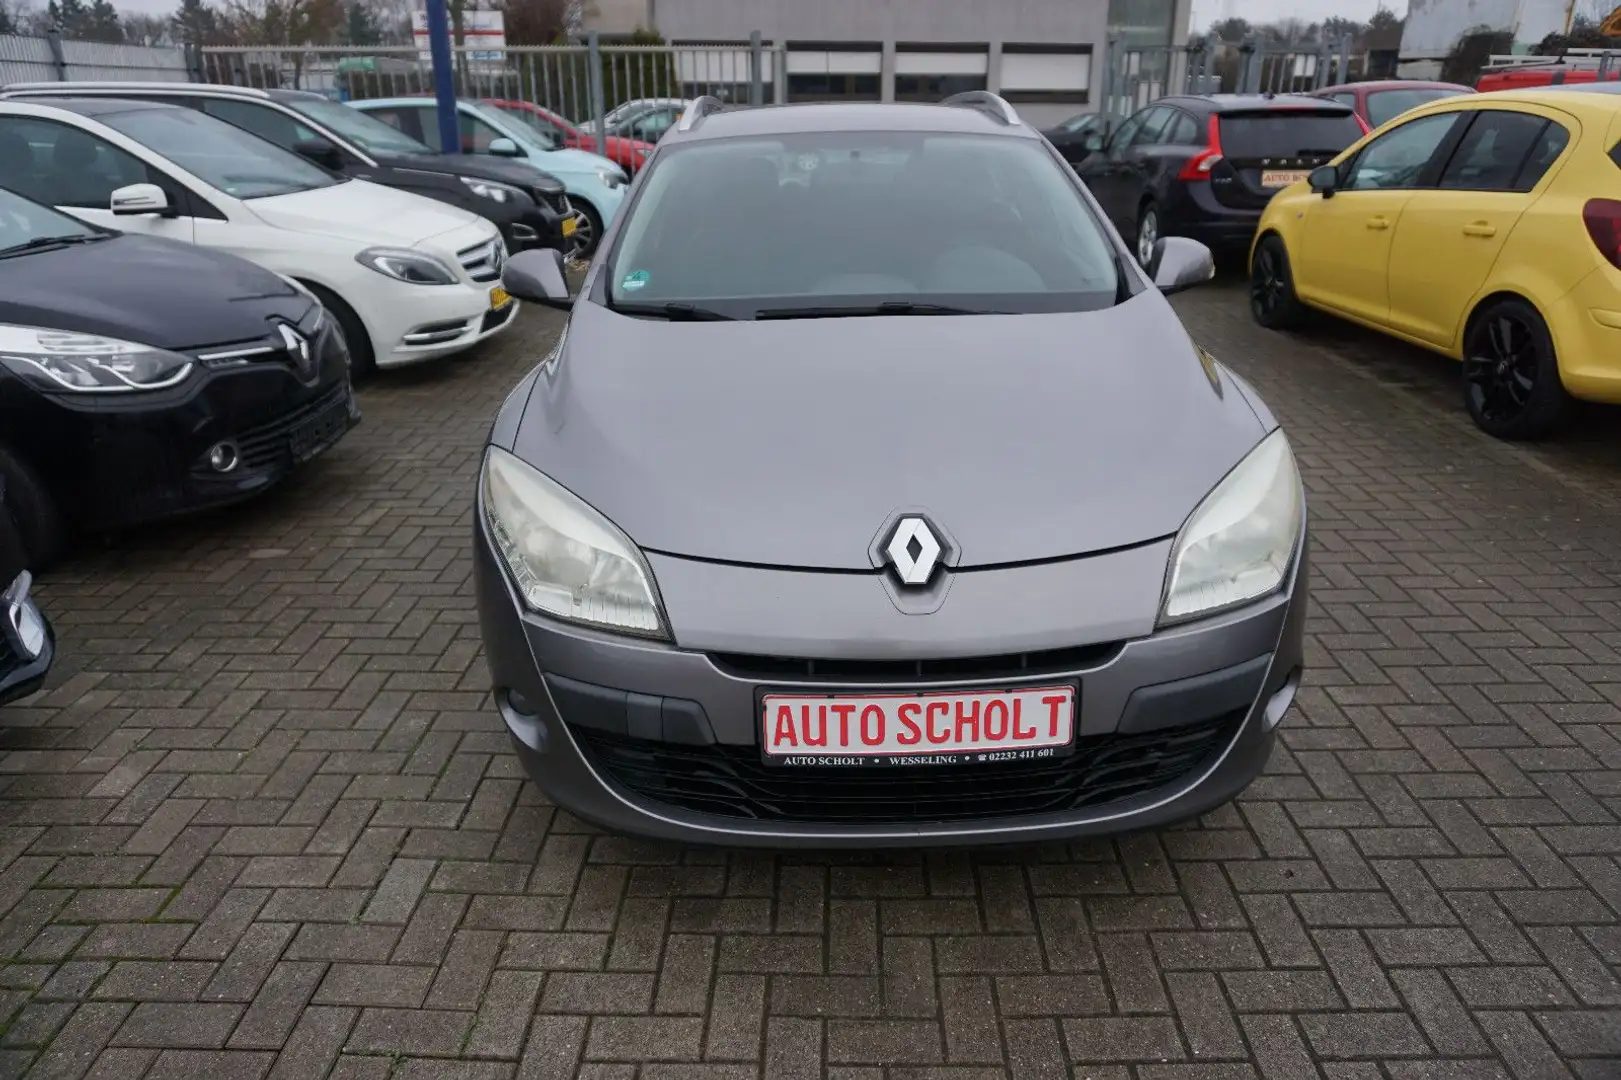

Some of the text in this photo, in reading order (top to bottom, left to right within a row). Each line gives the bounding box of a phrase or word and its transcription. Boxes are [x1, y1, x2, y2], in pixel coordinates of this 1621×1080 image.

[774, 695, 1067, 747] AUTO SCHOLT
[783, 748, 1054, 766] AUTO SCHOLT WESSELING 02232 411 601
